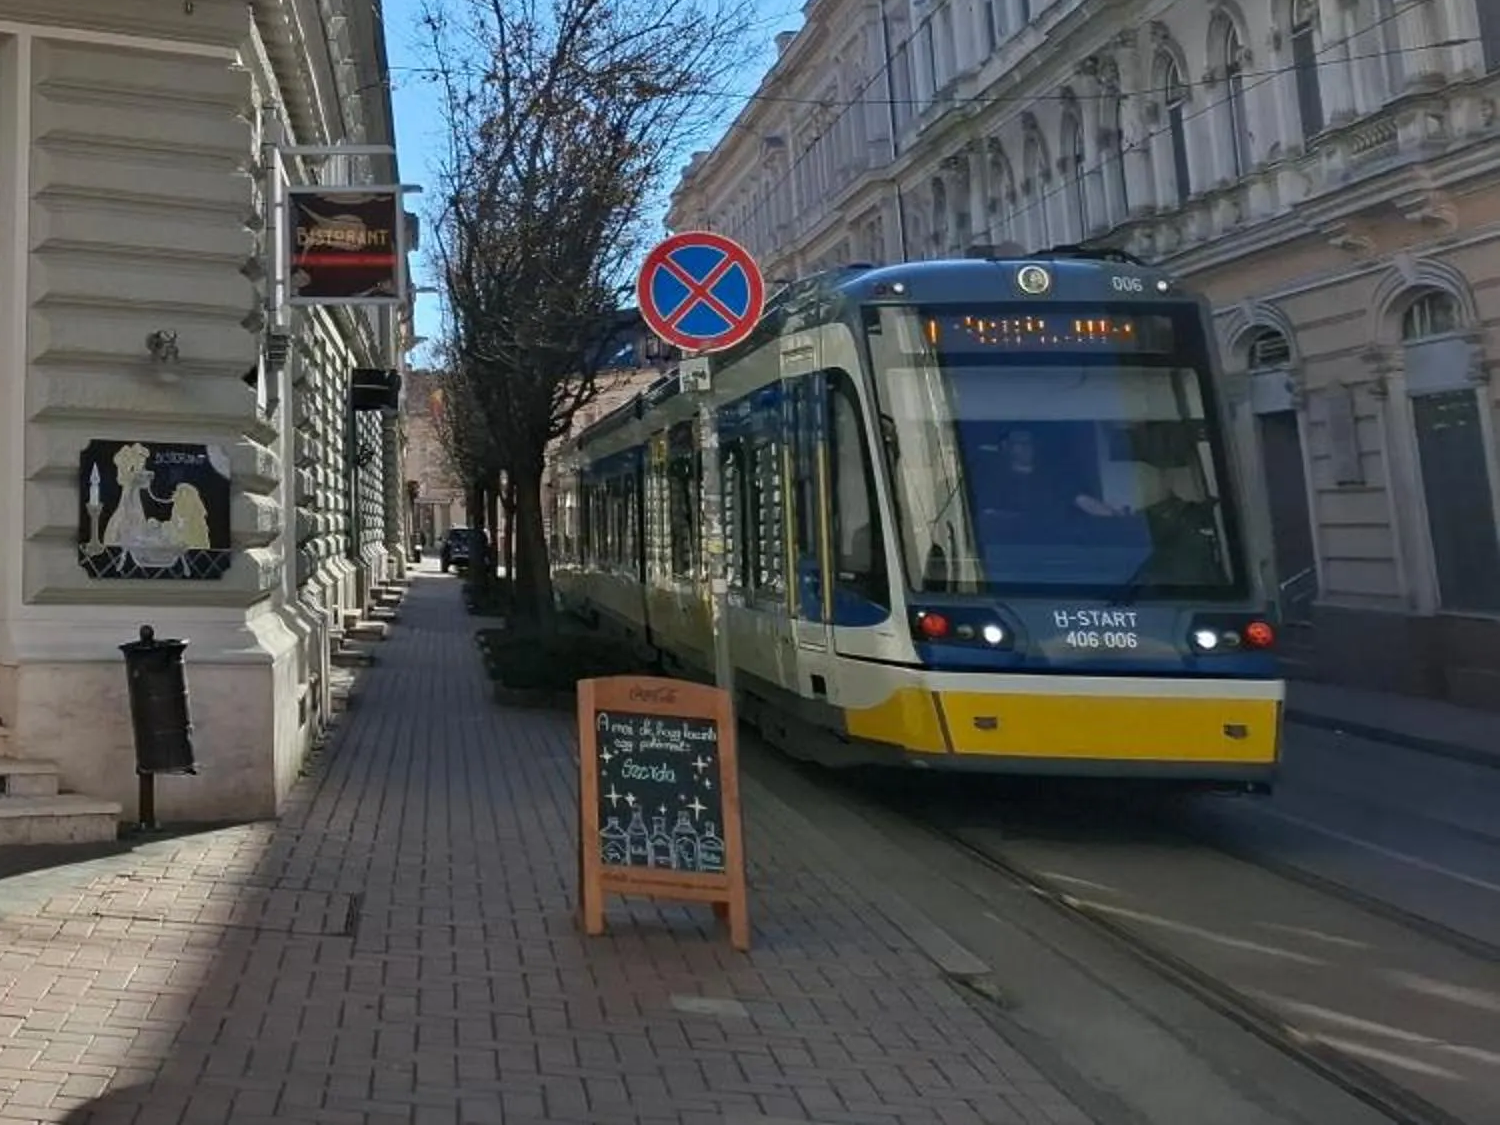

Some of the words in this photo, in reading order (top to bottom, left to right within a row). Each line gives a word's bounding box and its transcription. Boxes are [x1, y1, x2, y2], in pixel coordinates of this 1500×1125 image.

[297, 226, 390, 246] BISTORANT
[1112, 276, 1144, 292] 006
[1066, 631, 1099, 648] 406
[1103, 632, 1137, 649] 006
